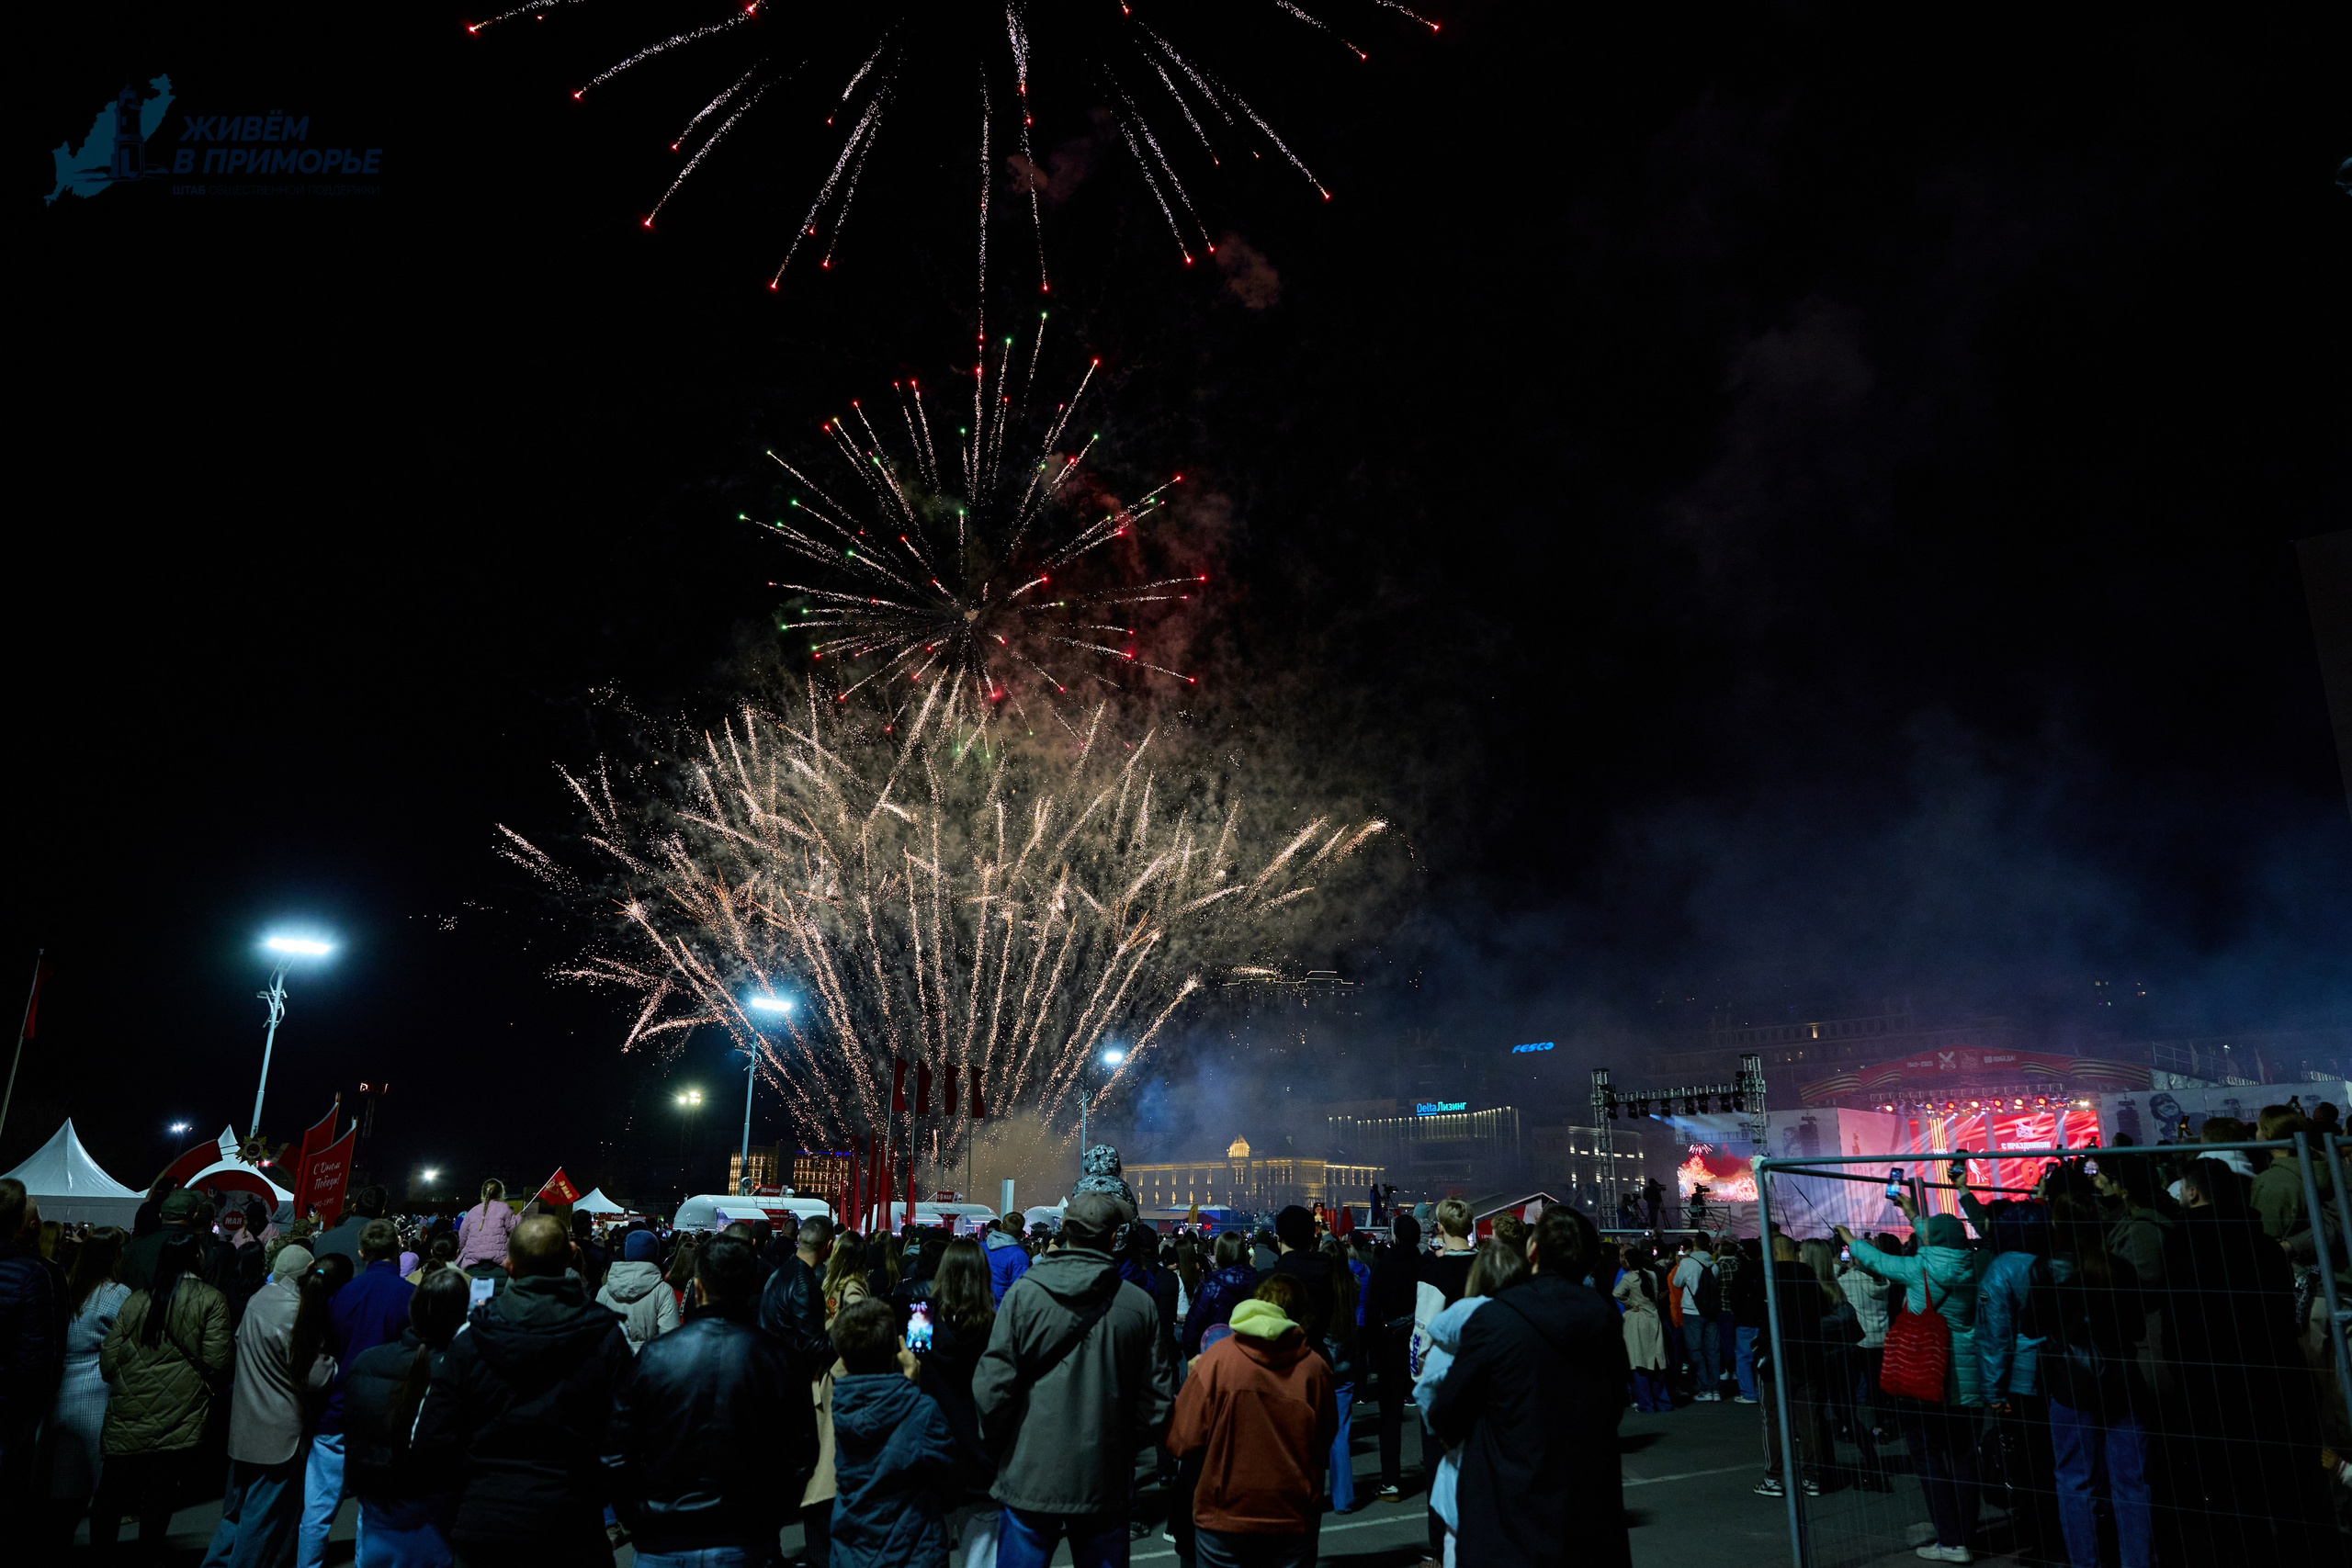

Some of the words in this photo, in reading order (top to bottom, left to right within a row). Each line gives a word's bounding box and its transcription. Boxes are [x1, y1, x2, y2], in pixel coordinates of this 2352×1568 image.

[1511, 1042, 1555, 1054] FESCO
[2007, 1142, 2052, 1151] ПРАЗДНИКОМ
[313, 1163, 320, 1175] С
[225, 1217, 243, 1225] МАЯ
